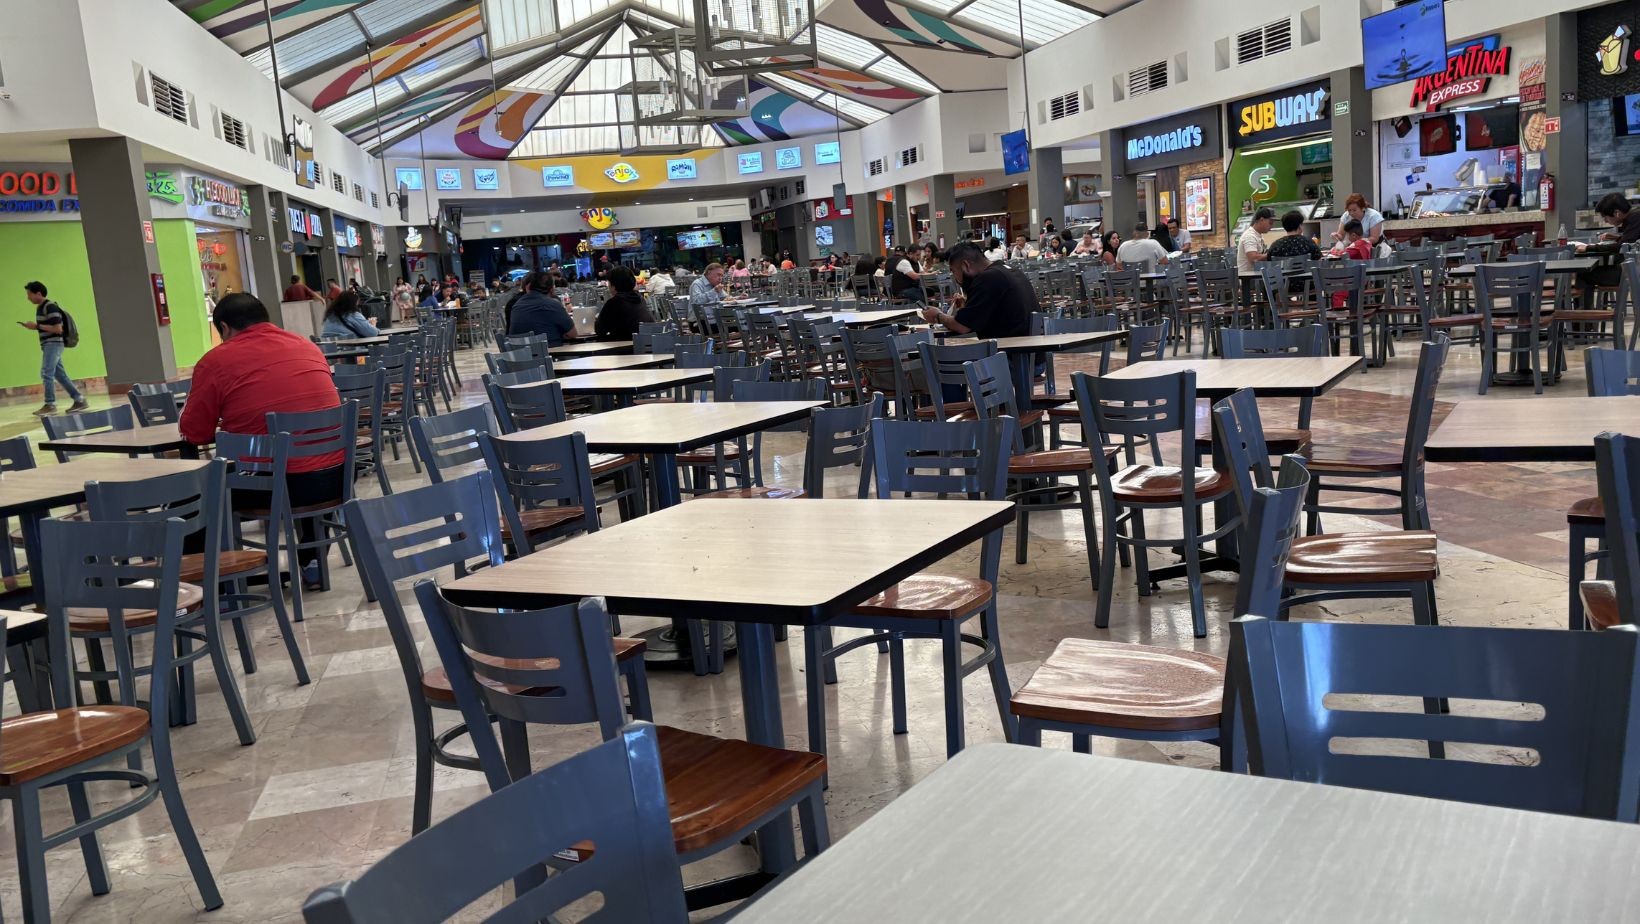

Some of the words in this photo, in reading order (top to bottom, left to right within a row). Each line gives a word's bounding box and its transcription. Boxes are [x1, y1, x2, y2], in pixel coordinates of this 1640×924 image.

[1430, 80, 1480, 104] EXPRESS
[1239, 87, 1326, 136] SUBWAY
[1128, 125, 1202, 160] McDonald's
